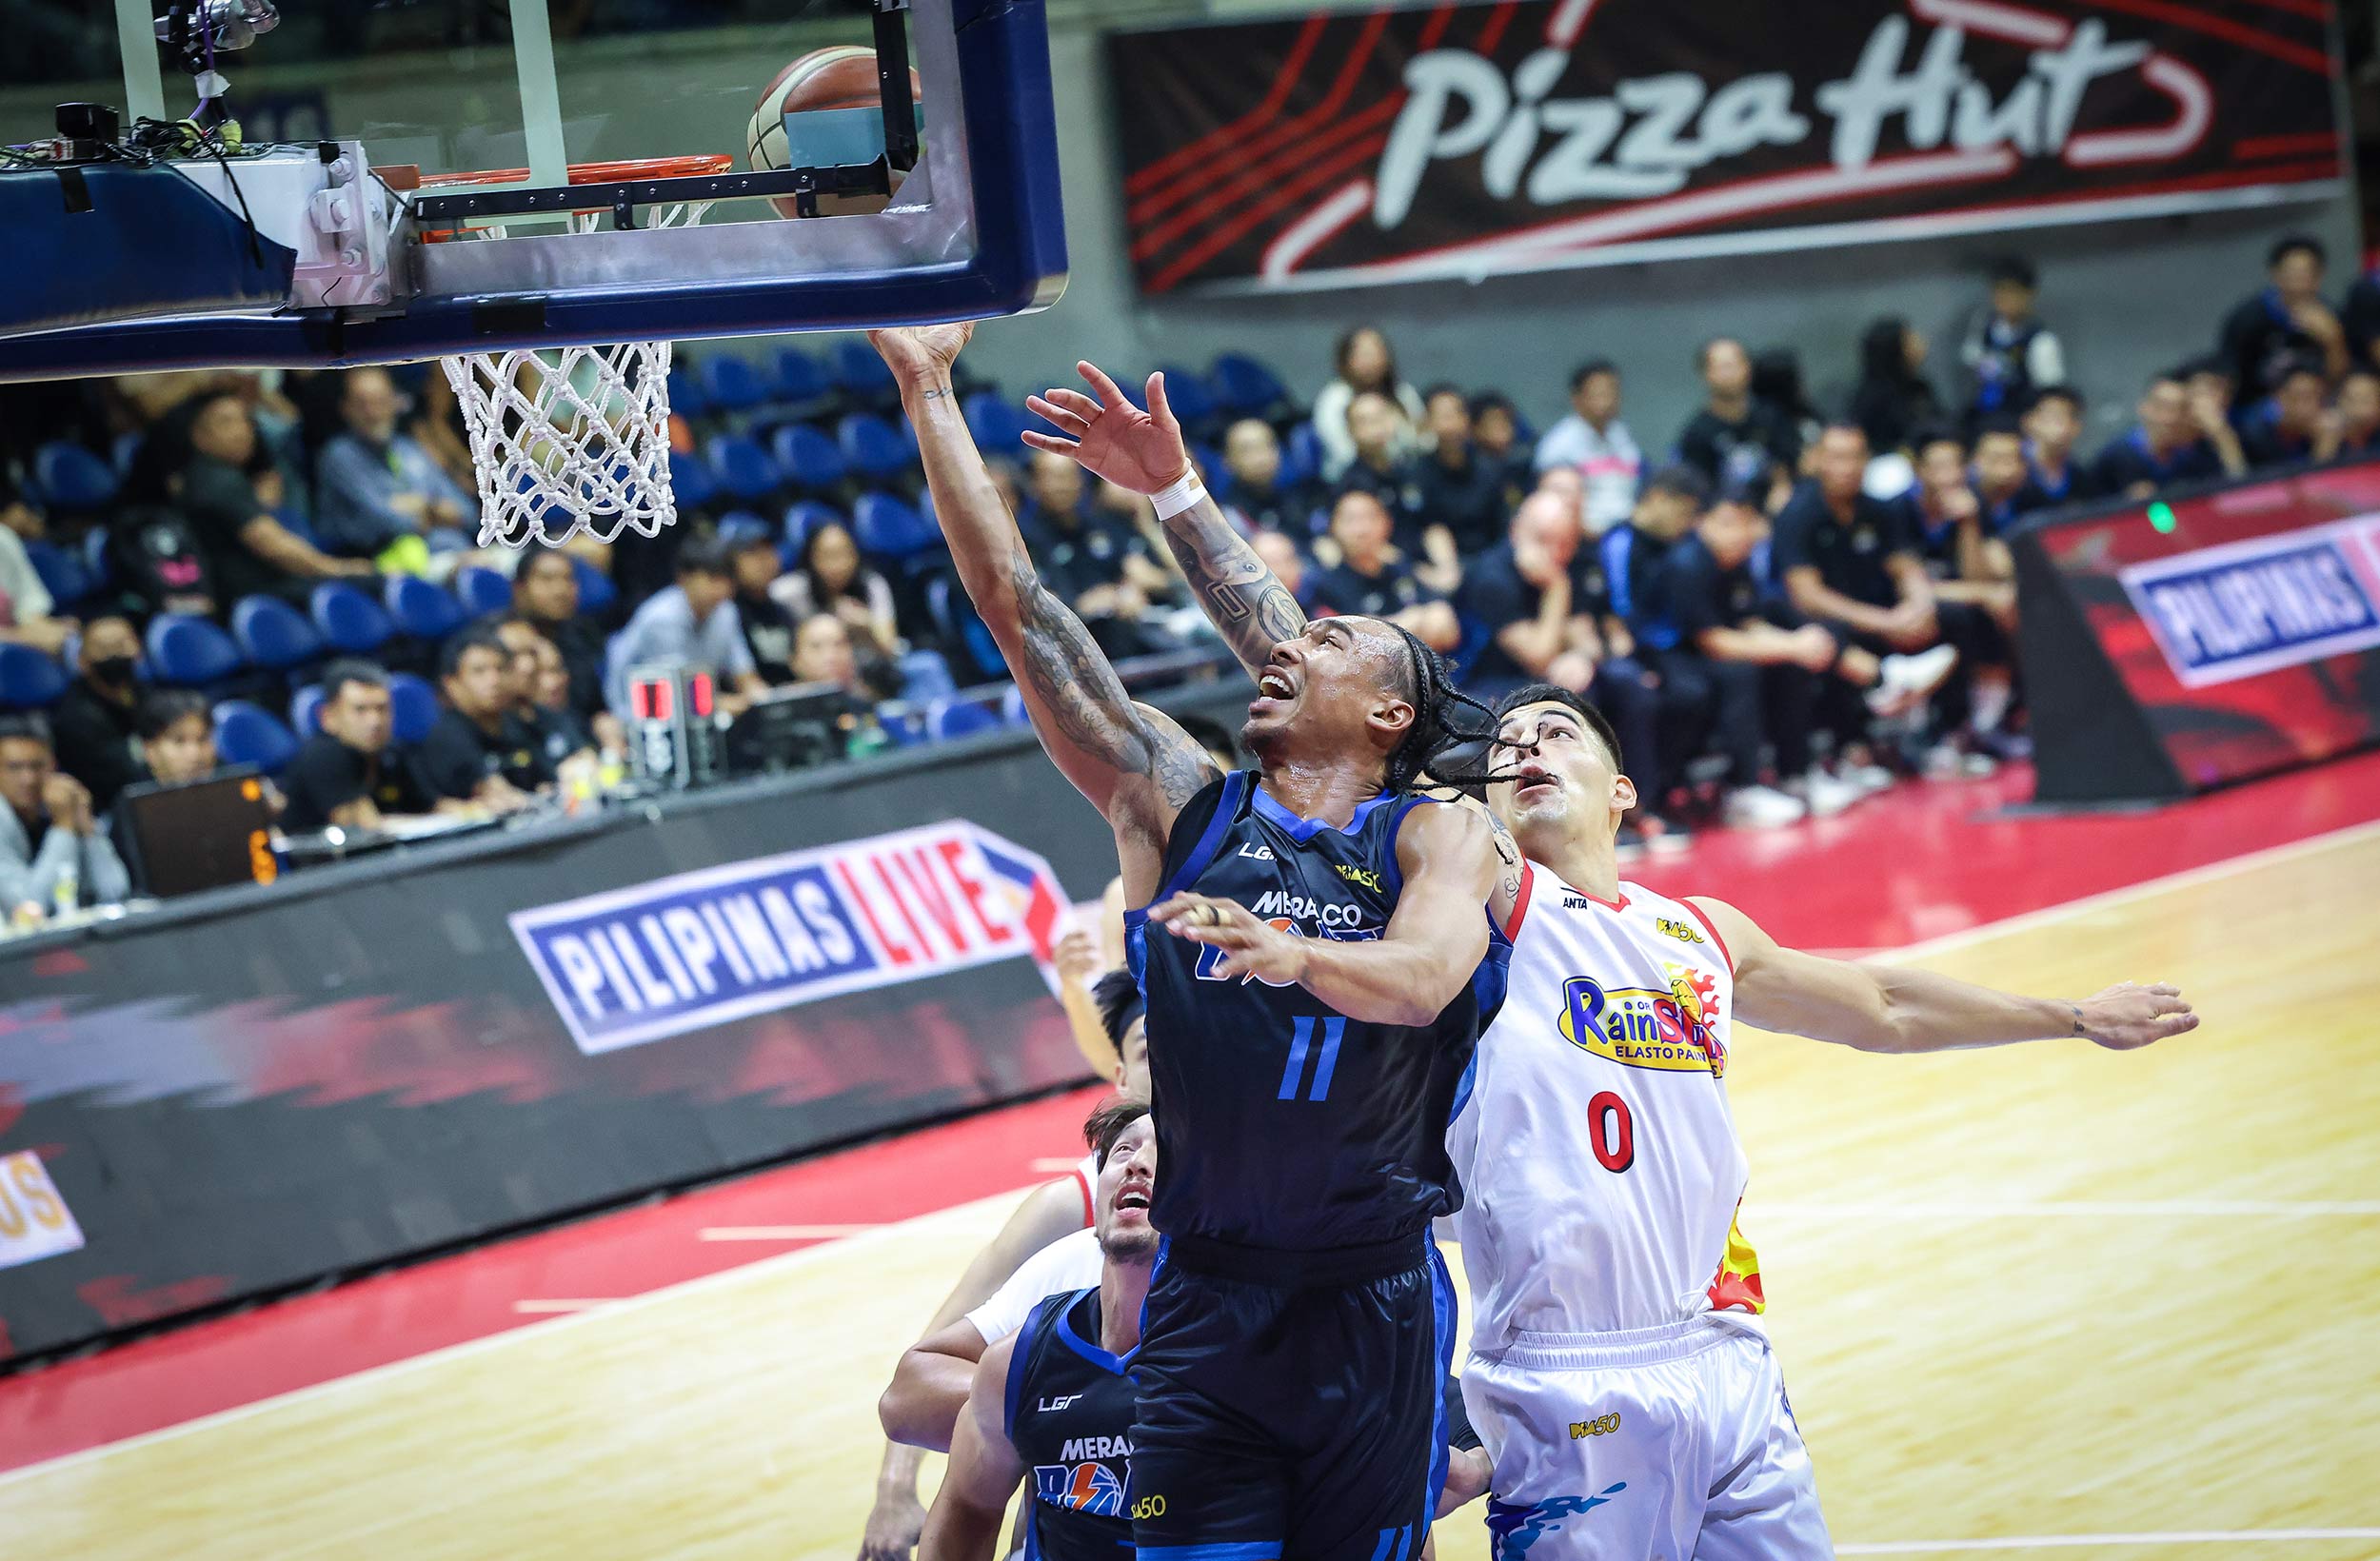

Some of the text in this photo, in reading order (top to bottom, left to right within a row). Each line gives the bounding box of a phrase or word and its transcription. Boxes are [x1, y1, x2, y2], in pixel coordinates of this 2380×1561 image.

[1373, 13, 2152, 230] Pizza Hut
[1238, 841, 1278, 862] LG
[549, 839, 1013, 1020] PILIPINAS LIVE
[1250, 890, 1362, 929] MERACO
[1562, 897, 1588, 910] ANTA
[1566, 978, 1657, 1046] Rain
[1277, 1015, 1348, 1102] 11
[1615, 1045, 1675, 1059] ELASTO
[1587, 1090, 1636, 1175] 0
